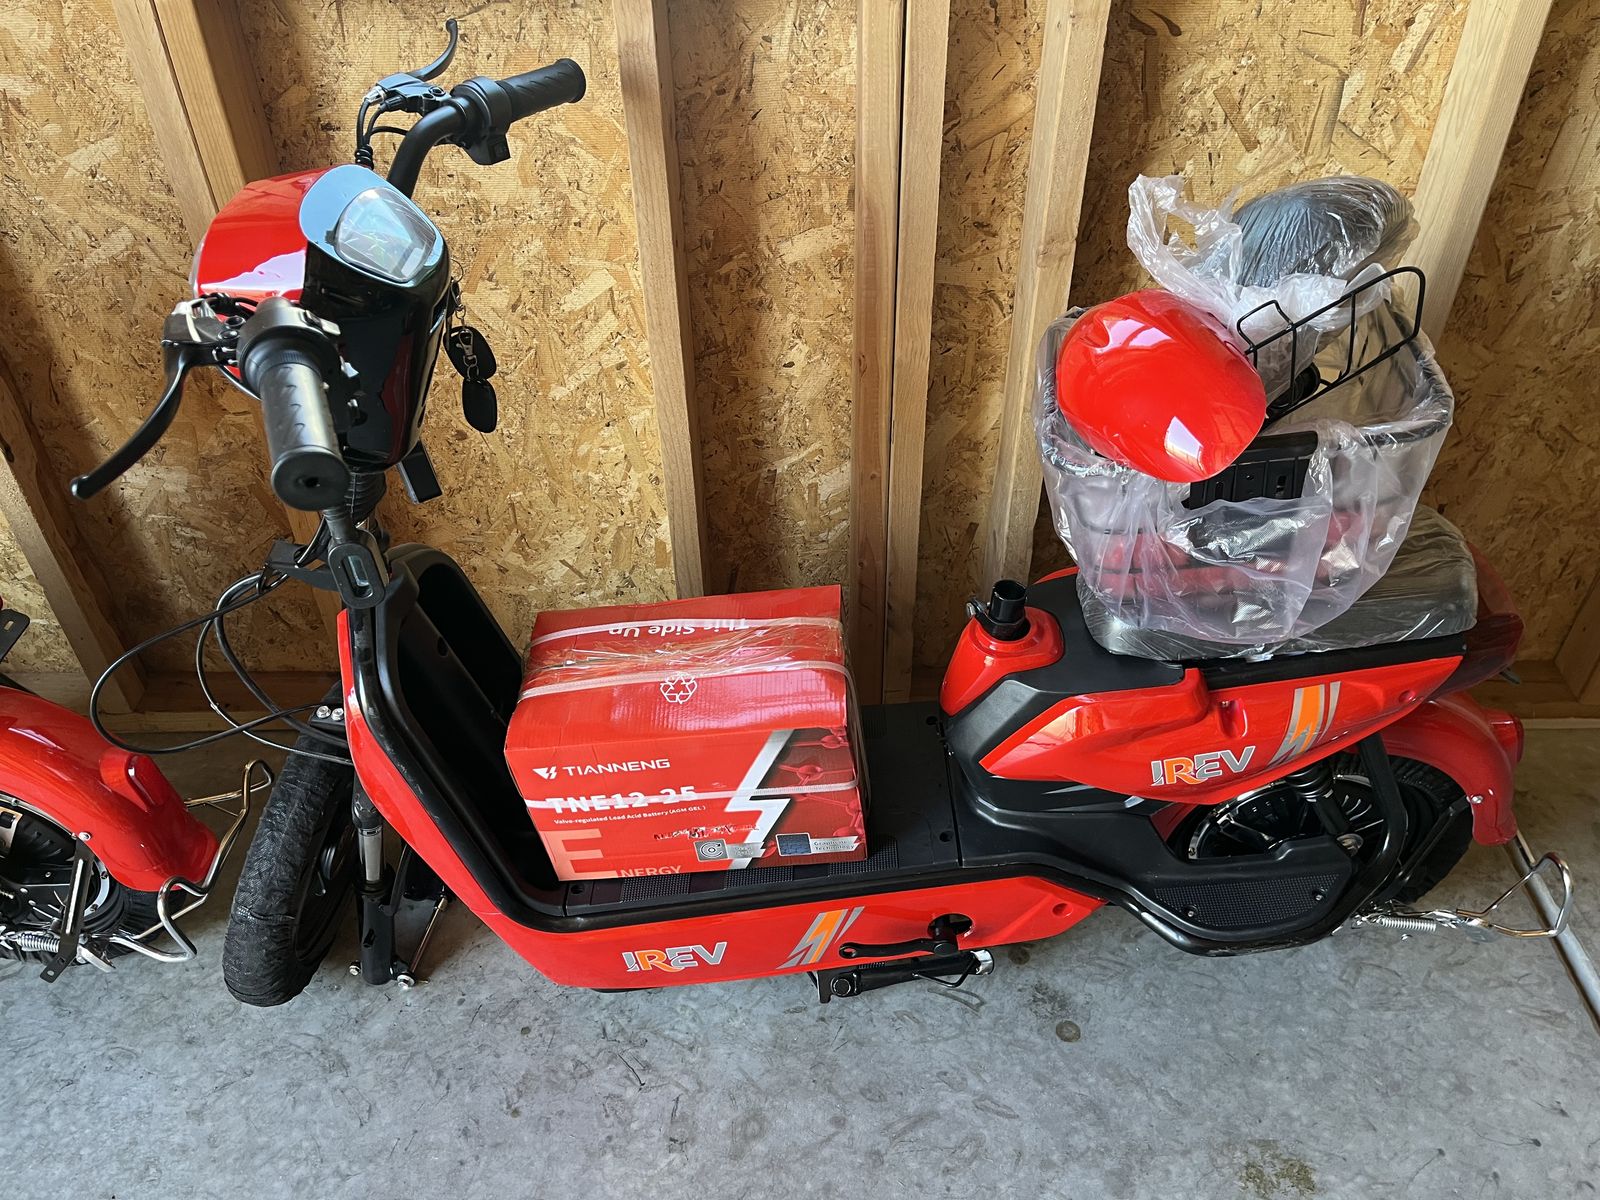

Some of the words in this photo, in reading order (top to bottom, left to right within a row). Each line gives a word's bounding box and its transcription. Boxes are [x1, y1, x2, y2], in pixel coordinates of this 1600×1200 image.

[648, 622, 695, 637] Side
[562, 758, 671, 777] TIANNENG
[1151, 745, 1256, 787] IREV
[545, 786, 698, 814] TNE12-25
[643, 810, 668, 819] Battery
[622, 941, 728, 973] IREV
